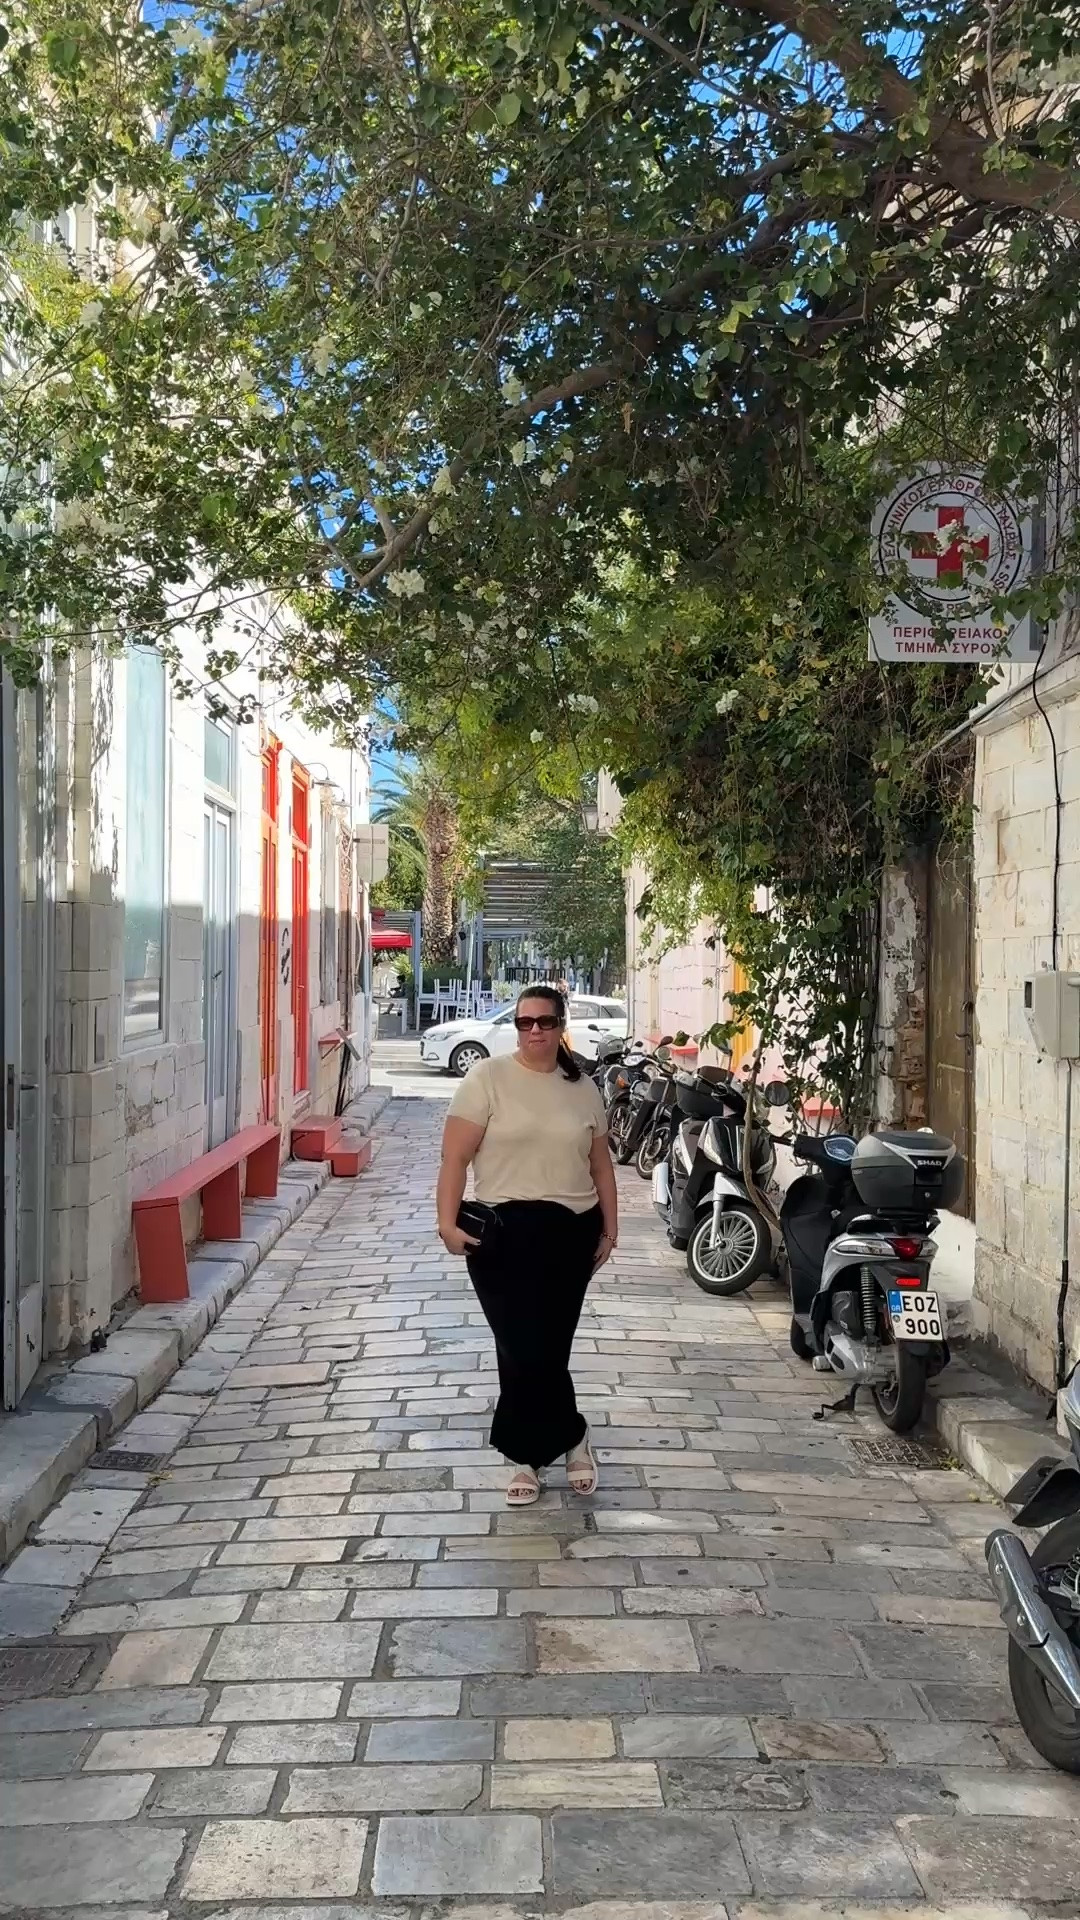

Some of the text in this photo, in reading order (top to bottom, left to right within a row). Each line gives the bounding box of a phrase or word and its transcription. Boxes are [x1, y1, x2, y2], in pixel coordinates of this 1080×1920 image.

[895, 641, 948, 654] ΤΜΗΜΑ
[917, 1159, 942, 1167] SHAD
[891, 1304, 901, 1312] GR
[905, 1317, 941, 1336] 900
